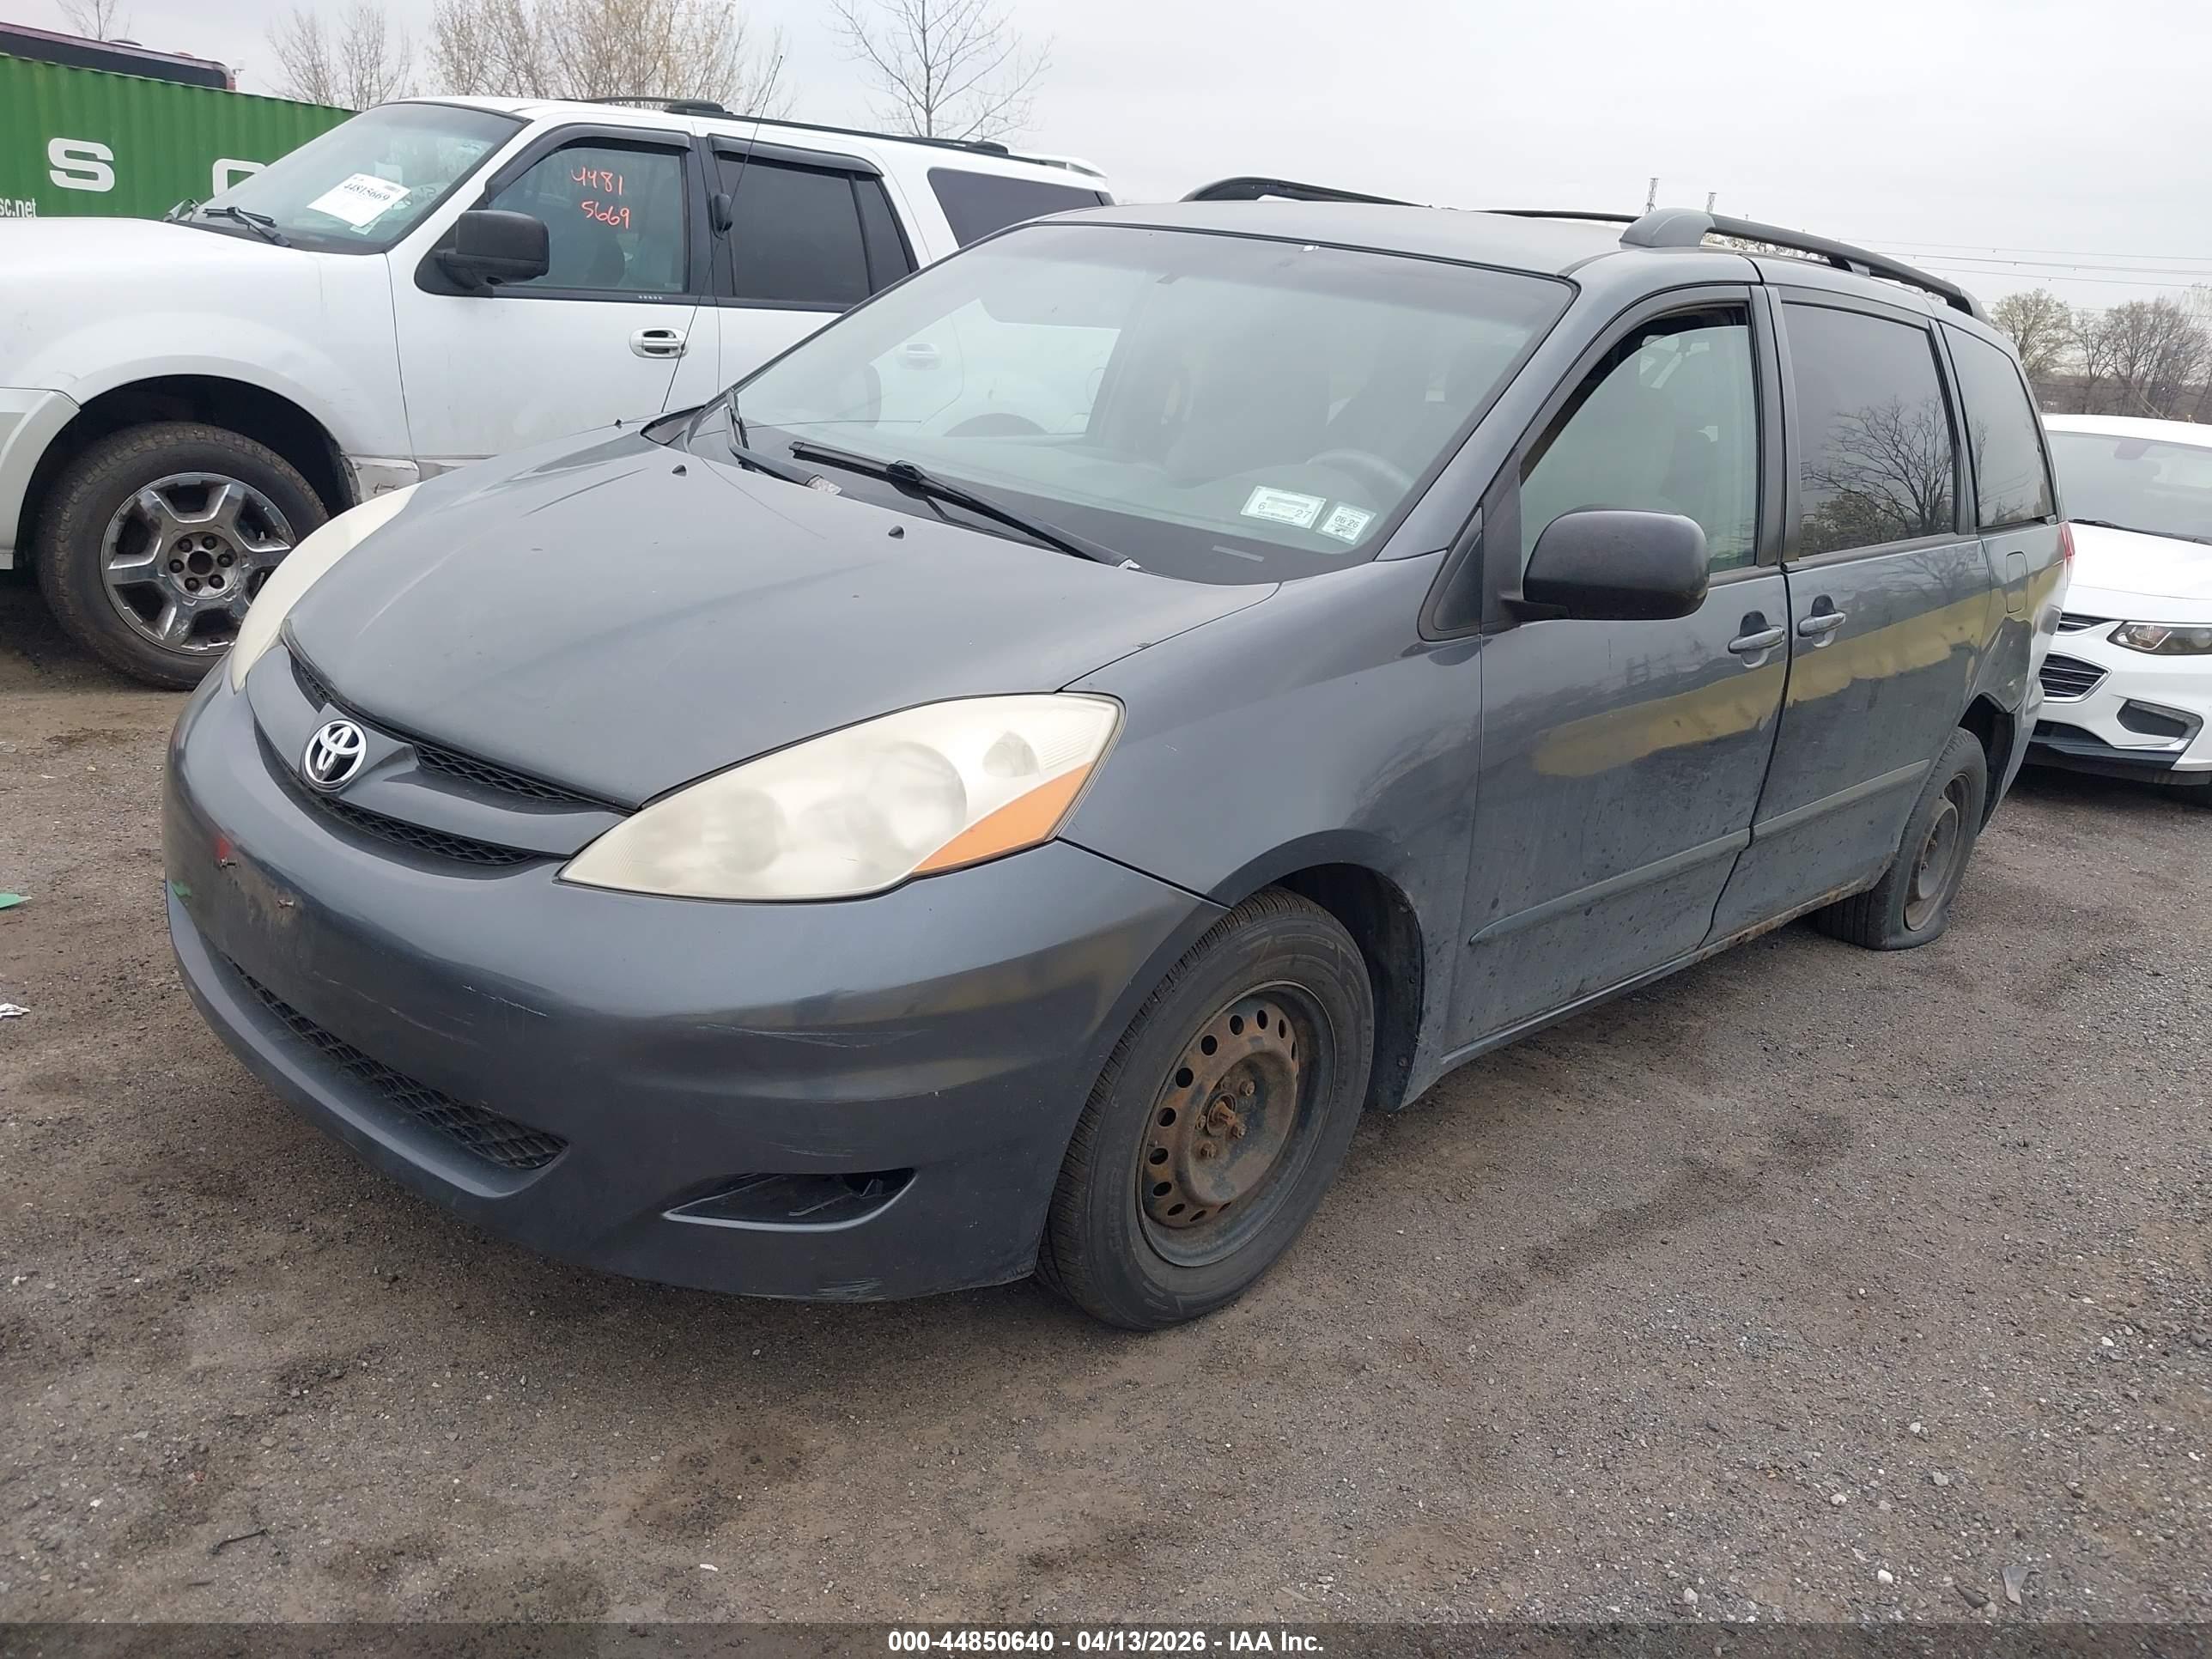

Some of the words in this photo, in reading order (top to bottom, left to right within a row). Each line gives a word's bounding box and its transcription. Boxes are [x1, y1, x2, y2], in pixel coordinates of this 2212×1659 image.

[570, 167, 623, 197] 4481
[581, 200, 630, 229] 5669
[1294, 508, 1313, 520] 27
